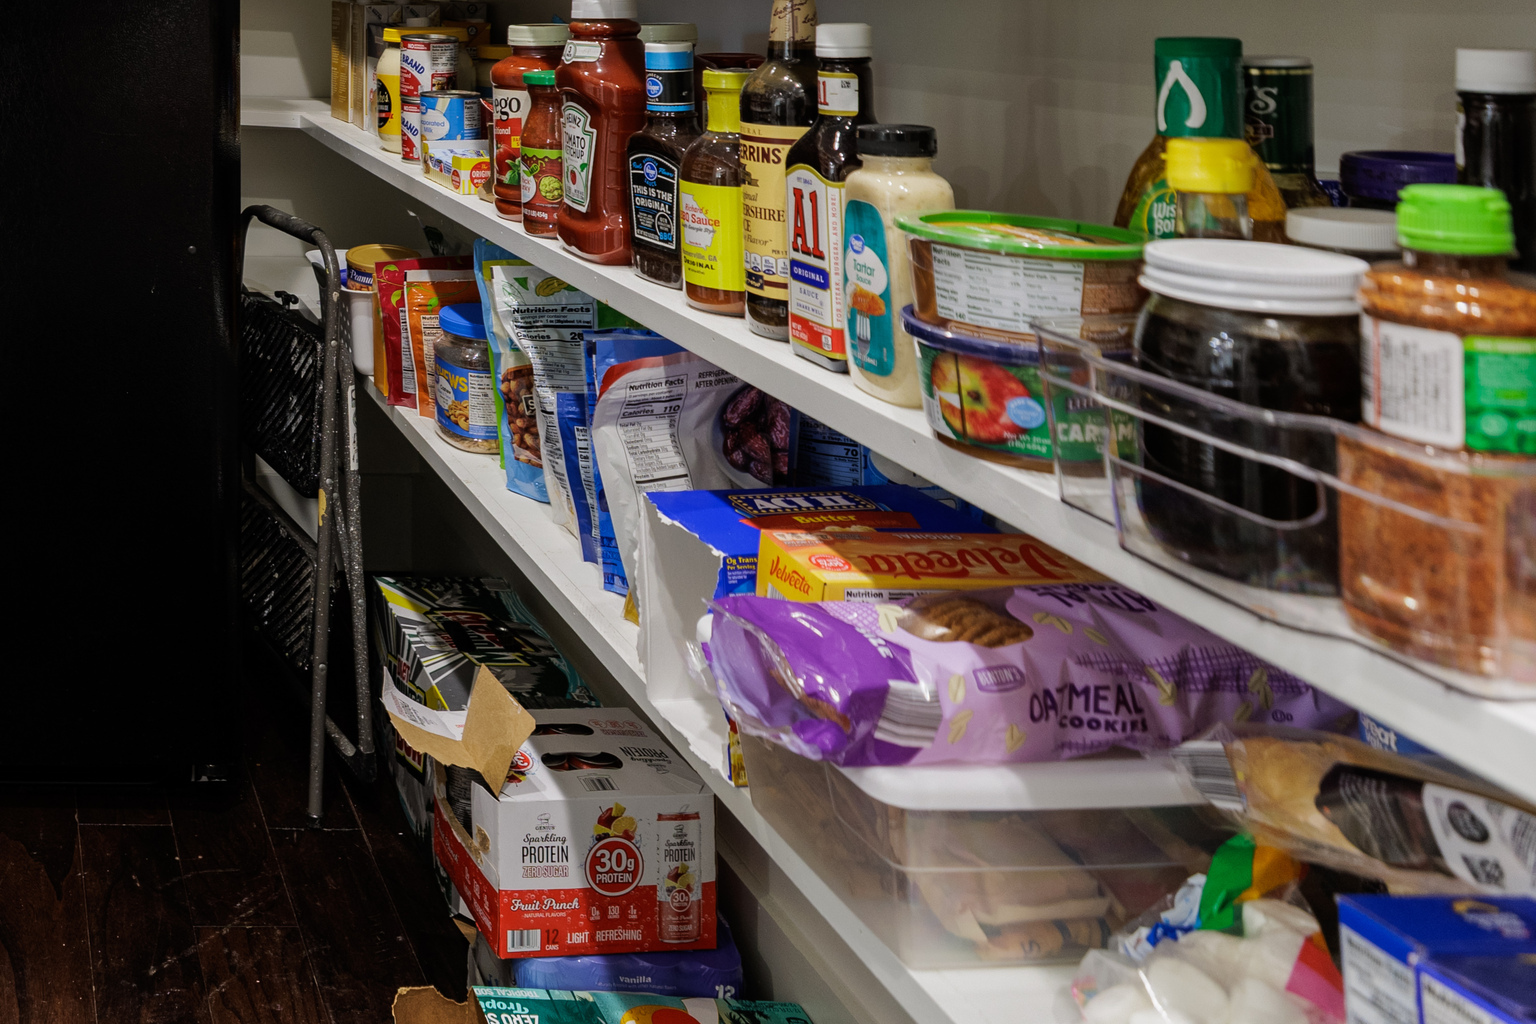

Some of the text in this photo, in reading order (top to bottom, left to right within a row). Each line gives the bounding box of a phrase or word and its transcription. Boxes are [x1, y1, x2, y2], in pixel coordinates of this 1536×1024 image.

[633, 185, 672, 202] THIS IS THE
[636, 197, 670, 213] ORIGINAL
[690, 213, 720, 227] Sauce
[793, 188, 825, 259] A1
[834, 239, 842, 276] BURGERS,
[793, 265, 825, 283] ORIGINAL
[853, 259, 876, 277] Tartar
[856, 274, 871, 285] Sauce
[799, 287, 819, 301] SAUCE
[664, 378, 684, 387] Facts
[754, 497, 813, 512] ACT
[794, 514, 858, 524] Butter
[859, 543, 1063, 577] Velveeta
[770, 556, 811, 597] Velveeta
[1030, 682, 1143, 722] OATMEAL
[523, 833, 567, 845] Sparkling
[521, 845, 569, 863] PROTEIN
[594, 849, 635, 873] 30g
[664, 848, 696, 862] PROTEIN
[596, 872, 632, 884] PROTEIN
[511, 899, 580, 913] Fruit Punch
[567, 929, 642, 944] LIGHT REFRESHING
[619, 975, 652, 985] vanilla
